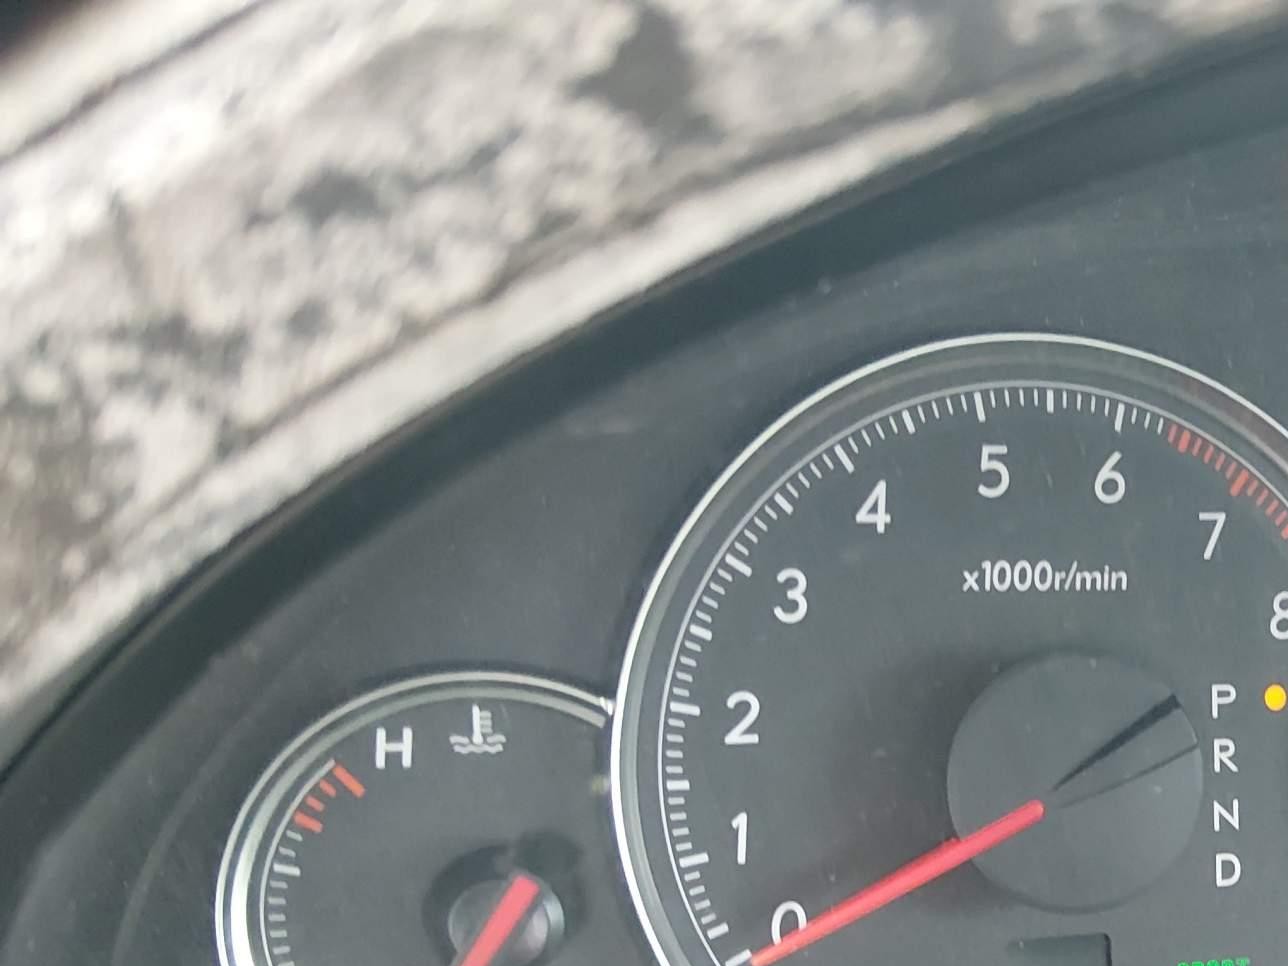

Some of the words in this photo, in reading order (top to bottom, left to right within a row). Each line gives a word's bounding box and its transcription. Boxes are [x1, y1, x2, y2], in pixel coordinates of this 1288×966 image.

[977, 443, 1012, 499] 5
[1094, 450, 1127, 504] 6
[856, 479, 892, 534] 4
[1198, 510, 1227, 561] 7
[774, 567, 808, 625] 3
[962, 561, 1129, 593] x1000r/min
[724, 691, 760, 746] 2
[1211, 683, 1237, 718] P
[375, 726, 414, 769] H
[1213, 737, 1238, 773] R
[1213, 796, 1239, 831] N
[731, 812, 748, 865] 1
[1214, 854, 1241, 888] D
[771, 900, 807, 946] 0
